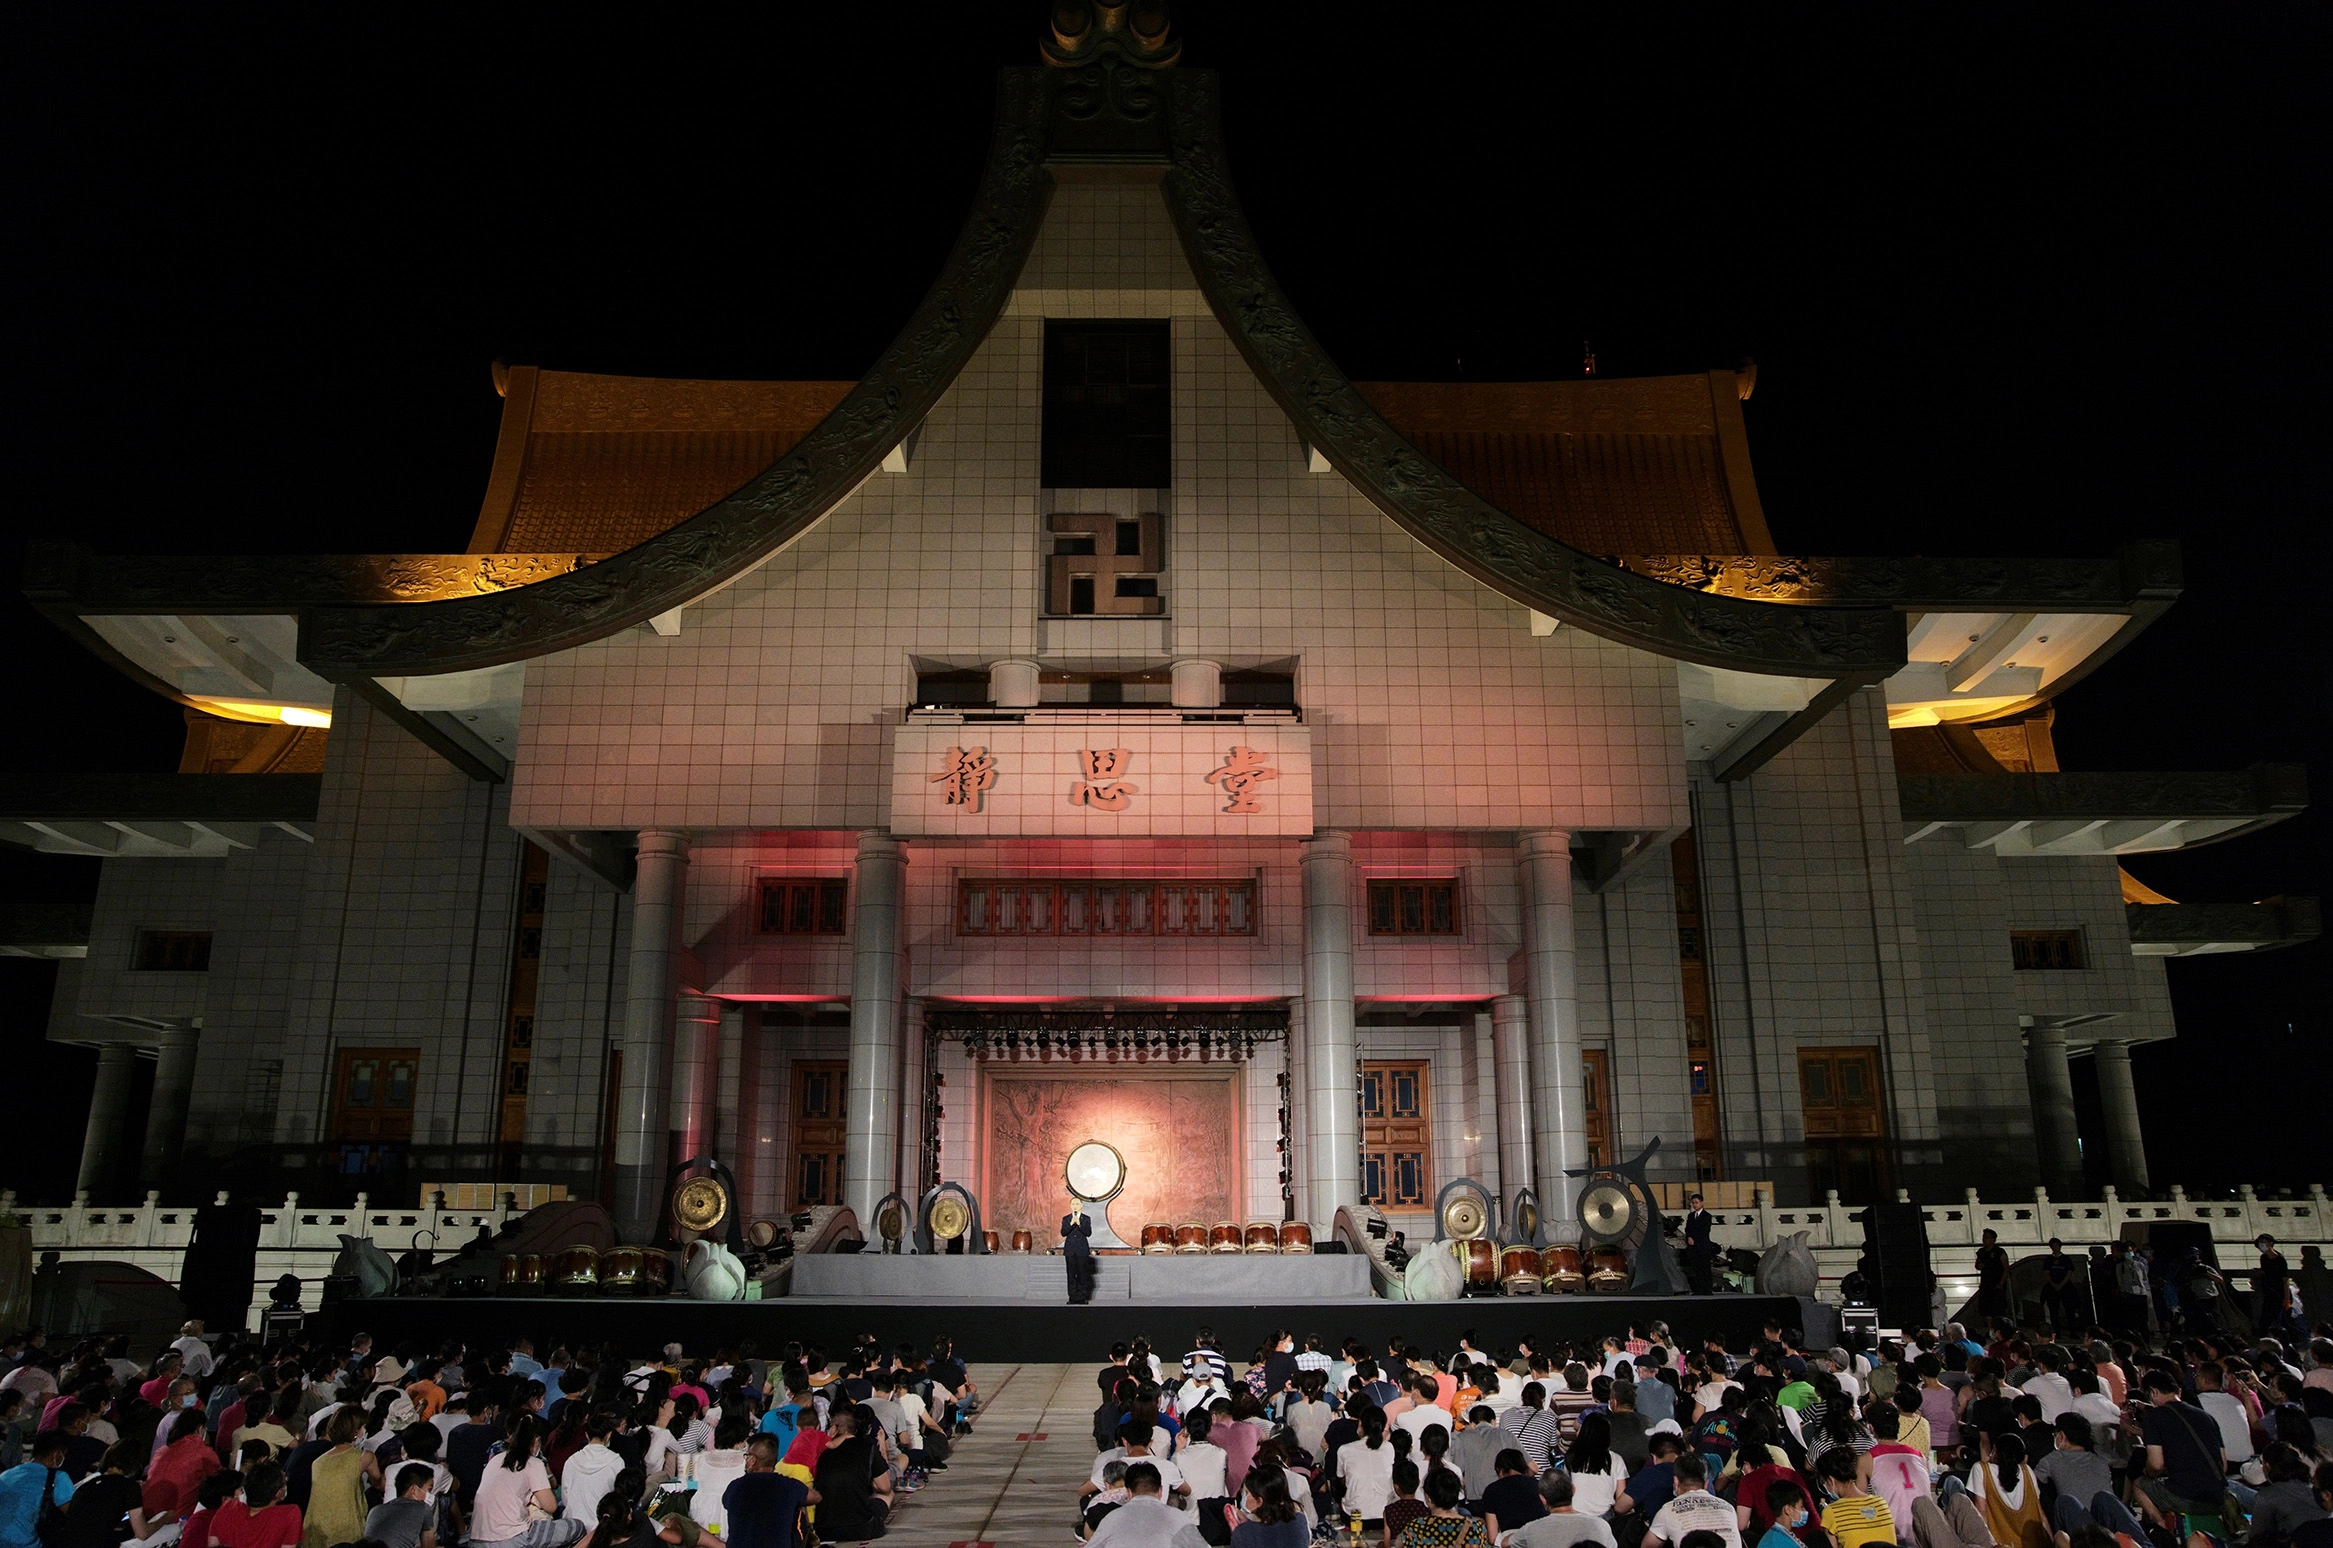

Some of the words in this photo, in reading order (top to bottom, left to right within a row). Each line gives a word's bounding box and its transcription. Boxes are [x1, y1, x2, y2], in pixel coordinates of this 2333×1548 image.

[930, 746, 1278, 813] 靜思堂
[1899, 1461, 1915, 1489] 1
